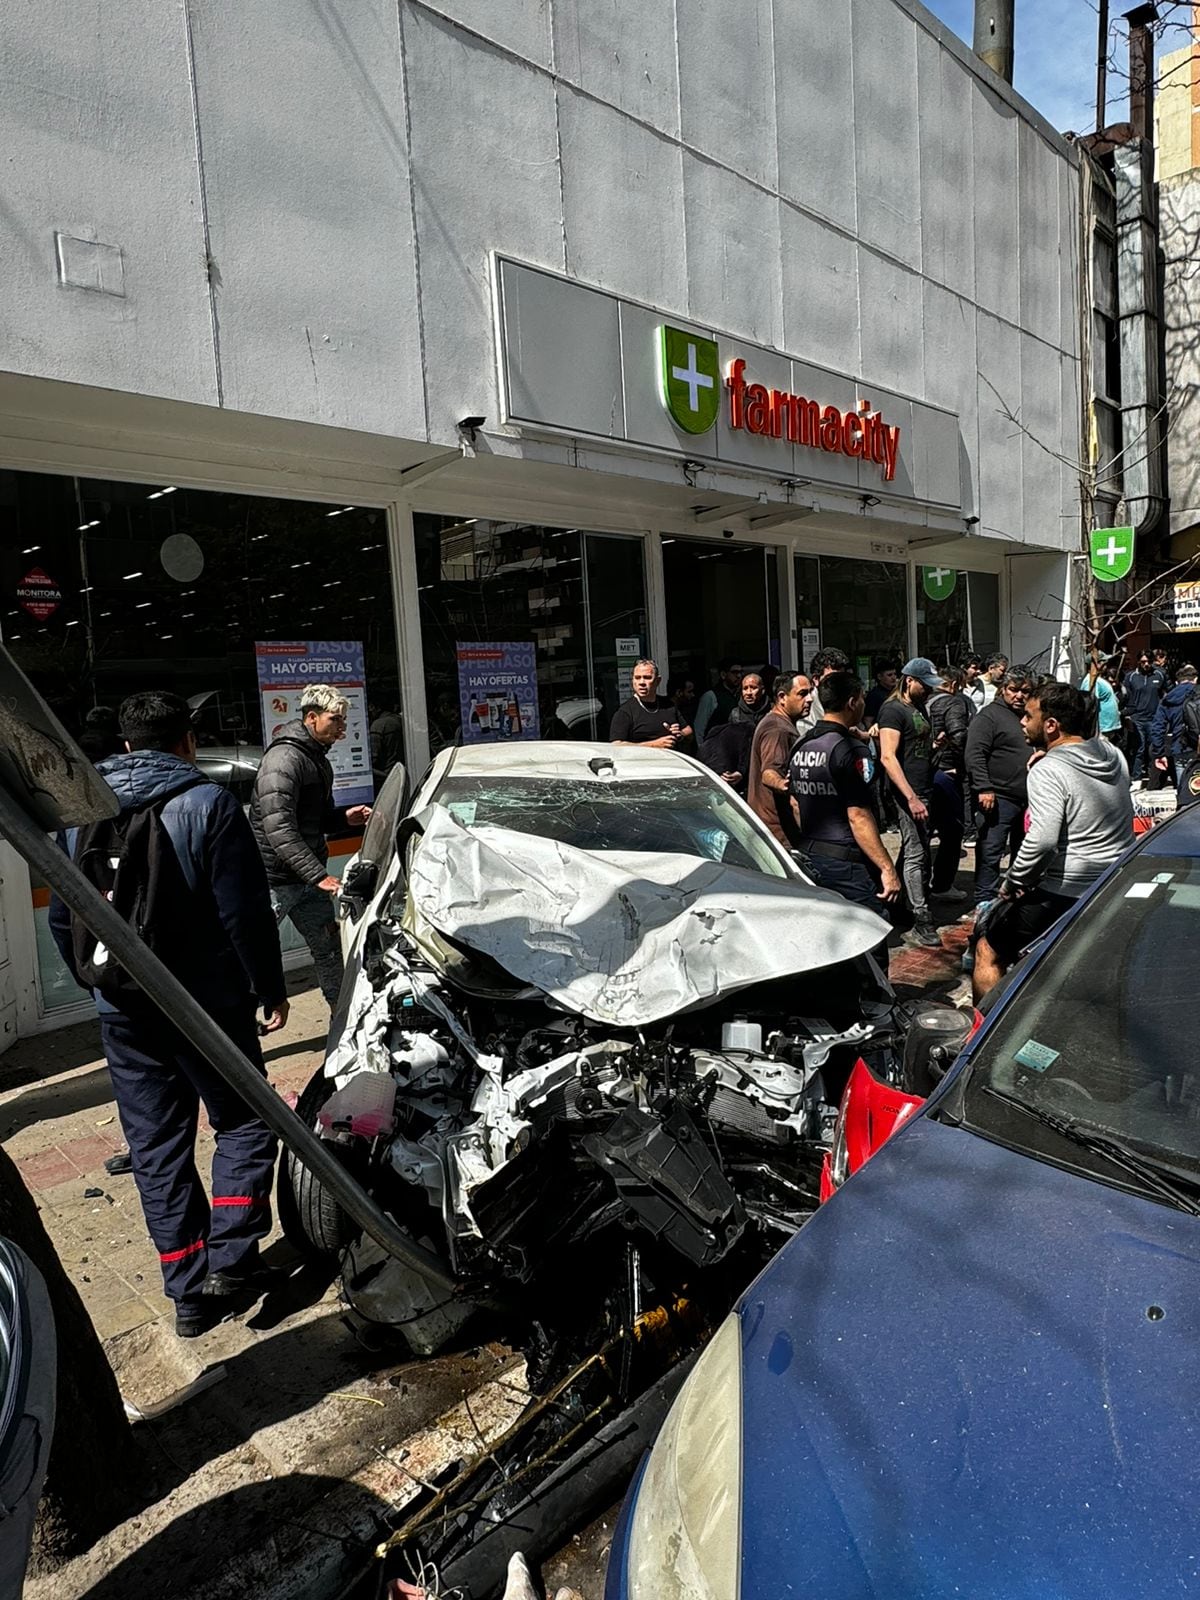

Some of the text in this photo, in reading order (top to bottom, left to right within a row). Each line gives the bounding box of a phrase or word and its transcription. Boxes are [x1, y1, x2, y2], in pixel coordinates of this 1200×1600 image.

[724, 358, 901, 481] farmacity
[16, 589, 61, 598] MONITORA
[620, 644, 636, 652] MET
[271, 663, 297, 674] HAY
[299, 662, 353, 674] OFERTAS
[469, 677, 488, 686] HAY
[489, 675, 528, 686] OFERTAS
[800, 768, 809, 779] DE
[794, 781, 838, 796] RDOBA
